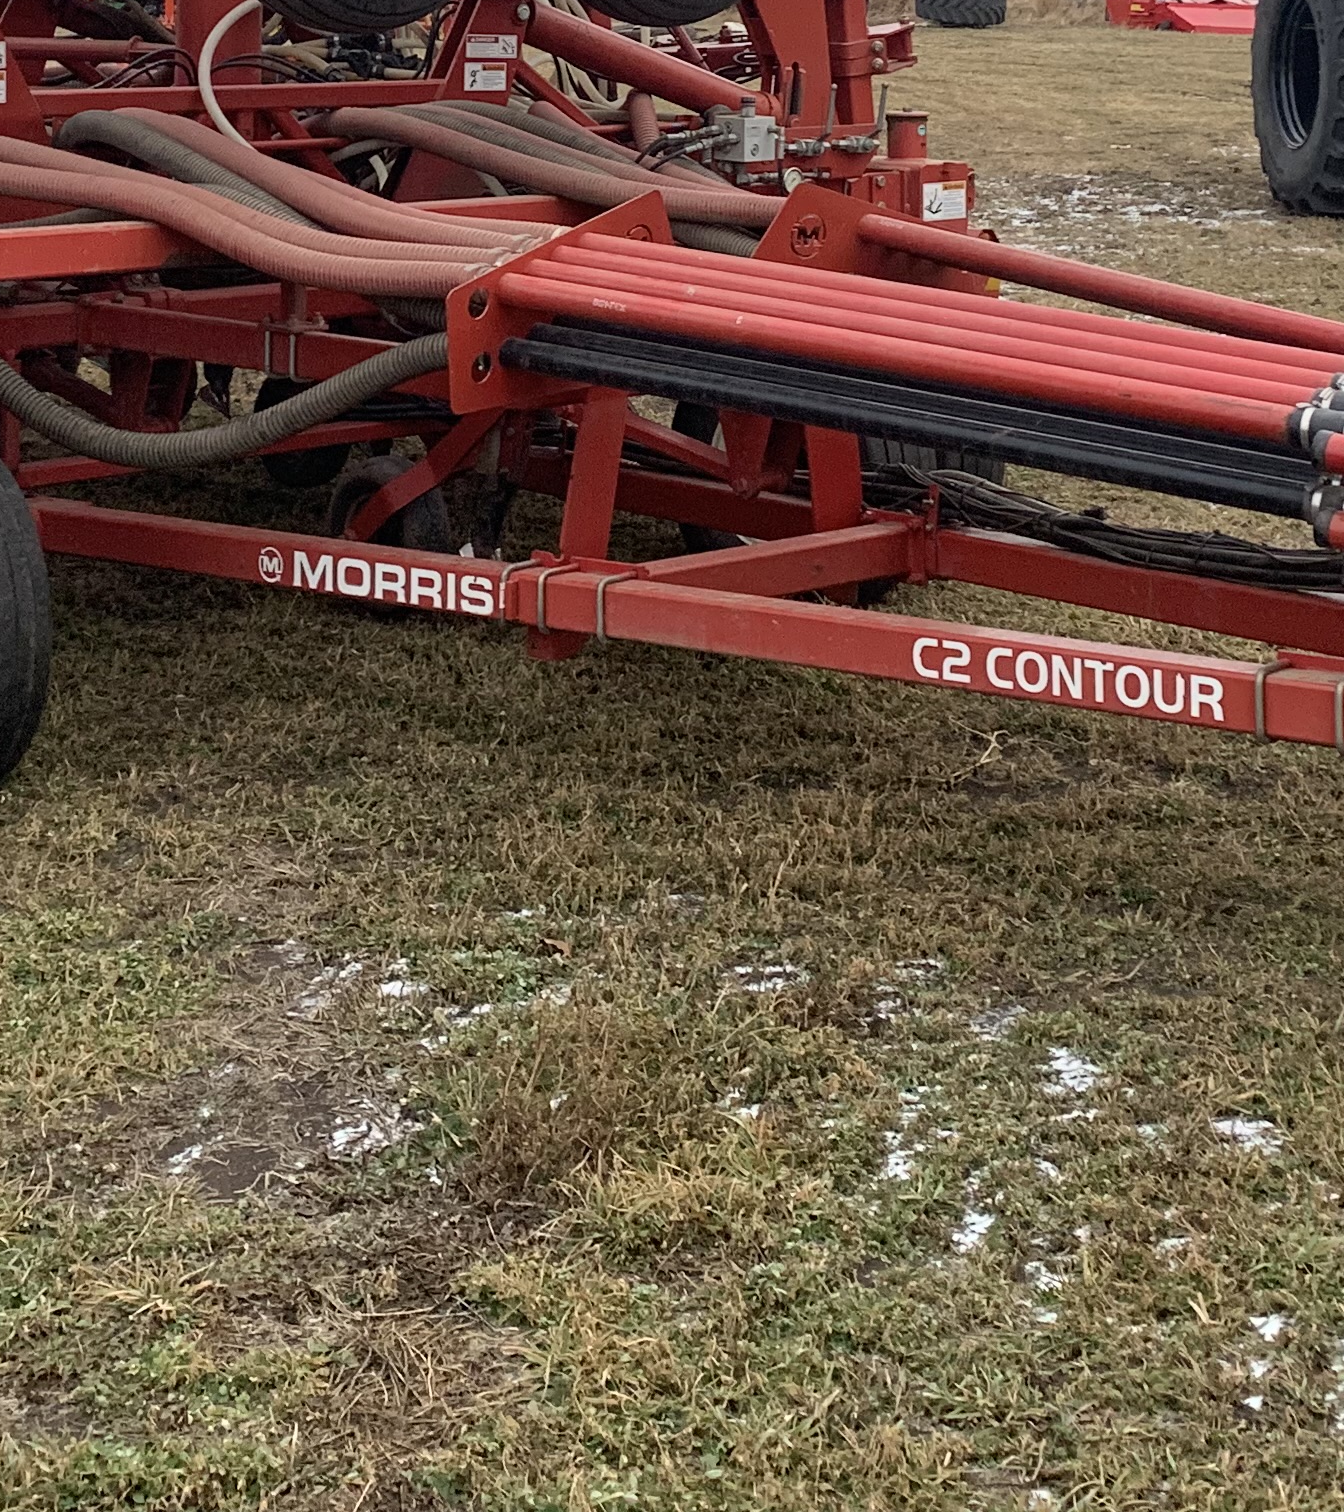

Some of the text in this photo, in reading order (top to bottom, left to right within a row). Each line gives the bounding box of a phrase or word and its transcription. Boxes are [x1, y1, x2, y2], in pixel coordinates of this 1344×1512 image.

[292, 550, 494, 616] MORRIS
[912, 637, 1225, 722] C2 CONTOUR
